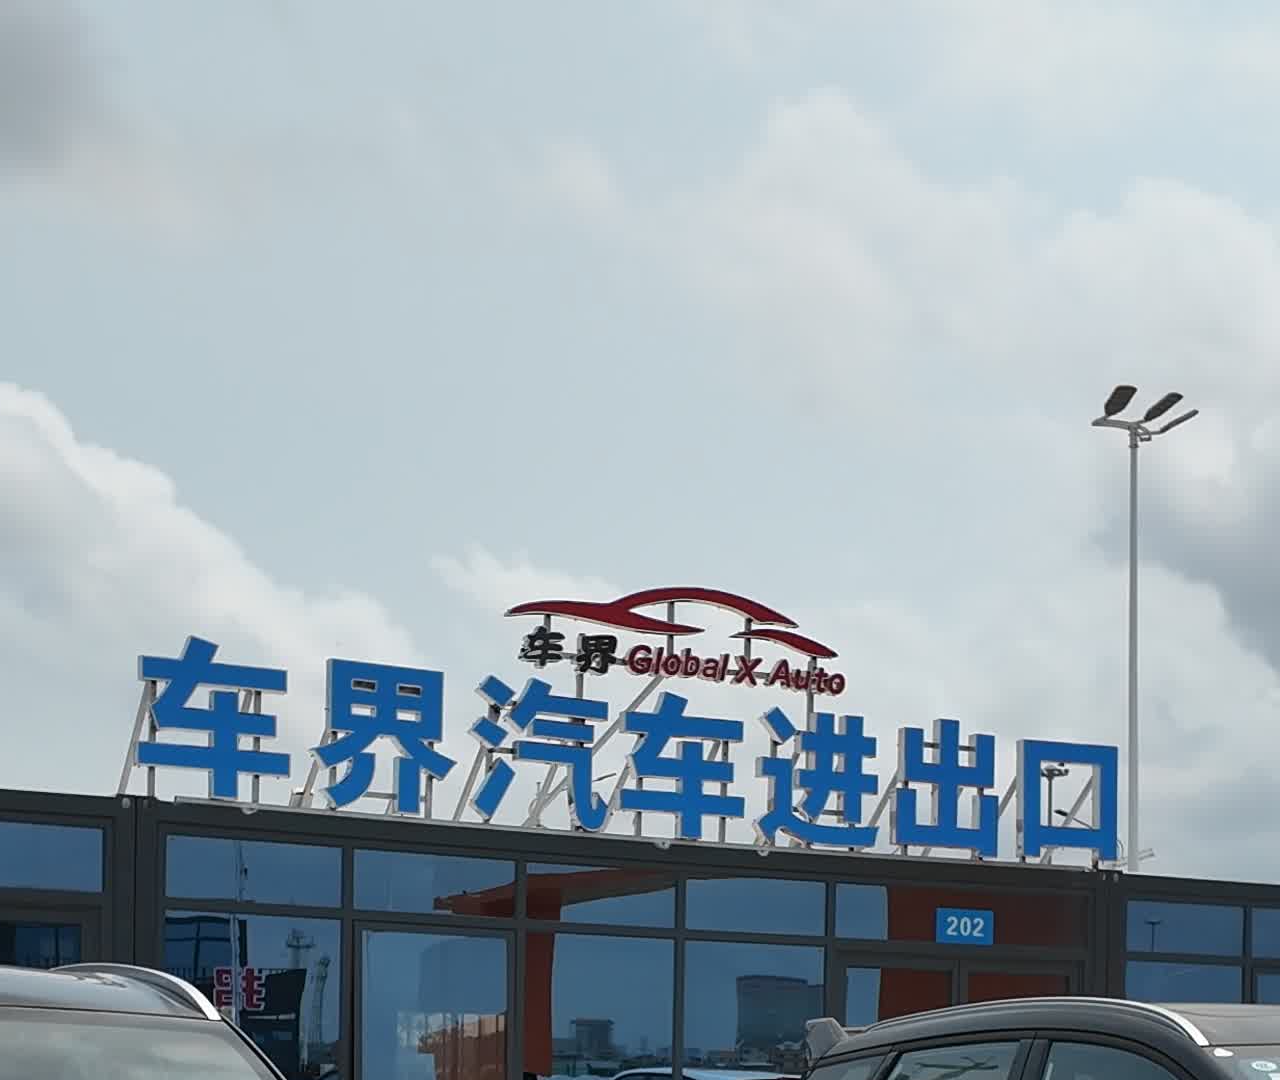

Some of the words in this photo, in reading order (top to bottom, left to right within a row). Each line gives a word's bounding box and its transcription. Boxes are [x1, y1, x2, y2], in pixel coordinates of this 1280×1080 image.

[519, 626, 618, 674] 车界
[627, 644, 727, 682] Global
[735, 653, 763, 687] X
[767, 658, 846, 696] Auto
[137, 637, 1118, 860] 车界汽车进出口
[946, 915, 985, 938] 202
